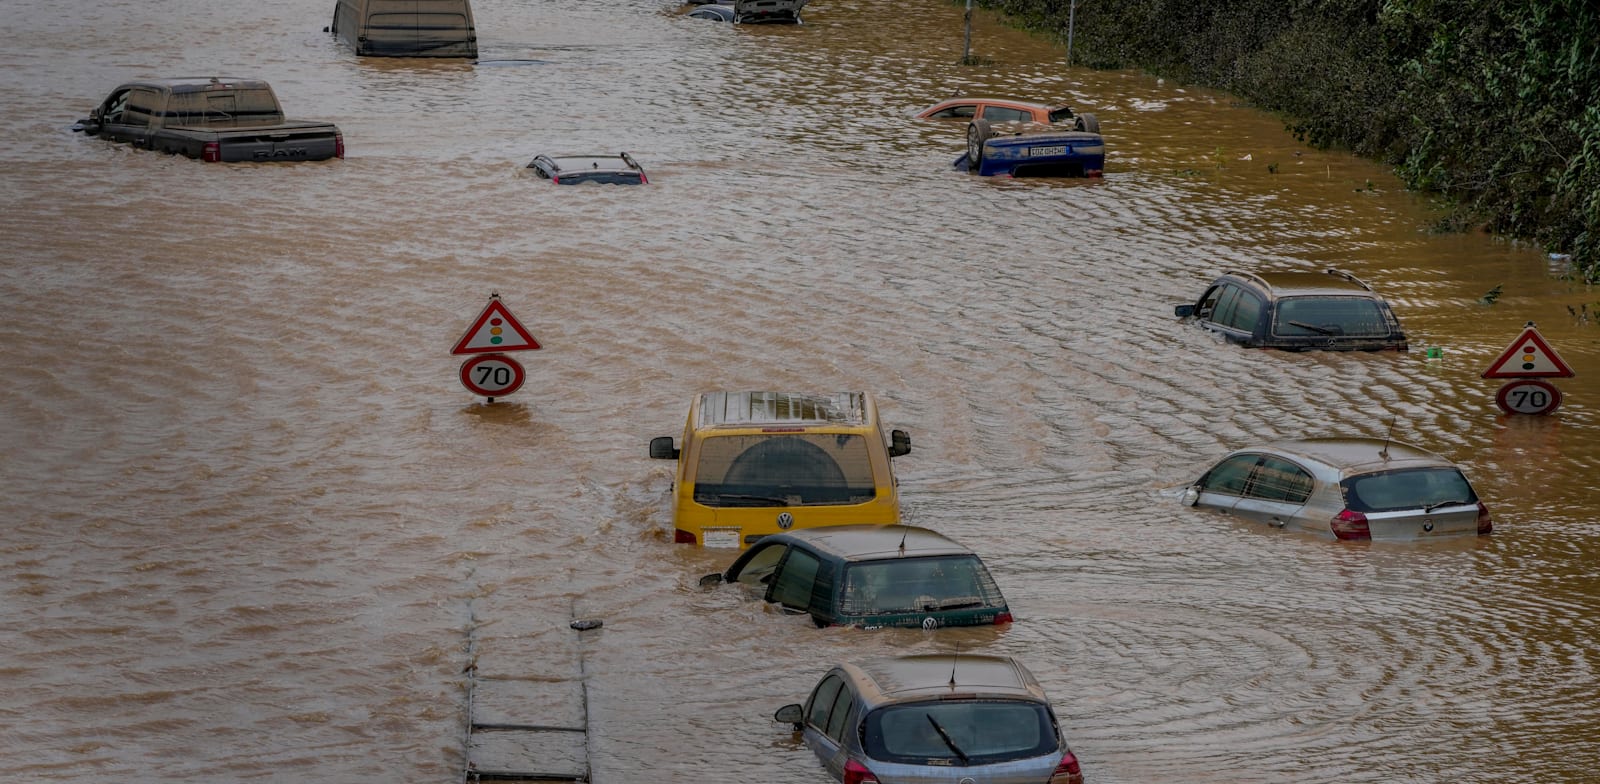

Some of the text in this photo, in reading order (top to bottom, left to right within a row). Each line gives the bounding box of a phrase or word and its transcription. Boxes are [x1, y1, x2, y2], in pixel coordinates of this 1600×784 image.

[253, 148, 307, 159] RAM
[477, 366, 510, 385] 70
[1512, 391, 1547, 408] 70
